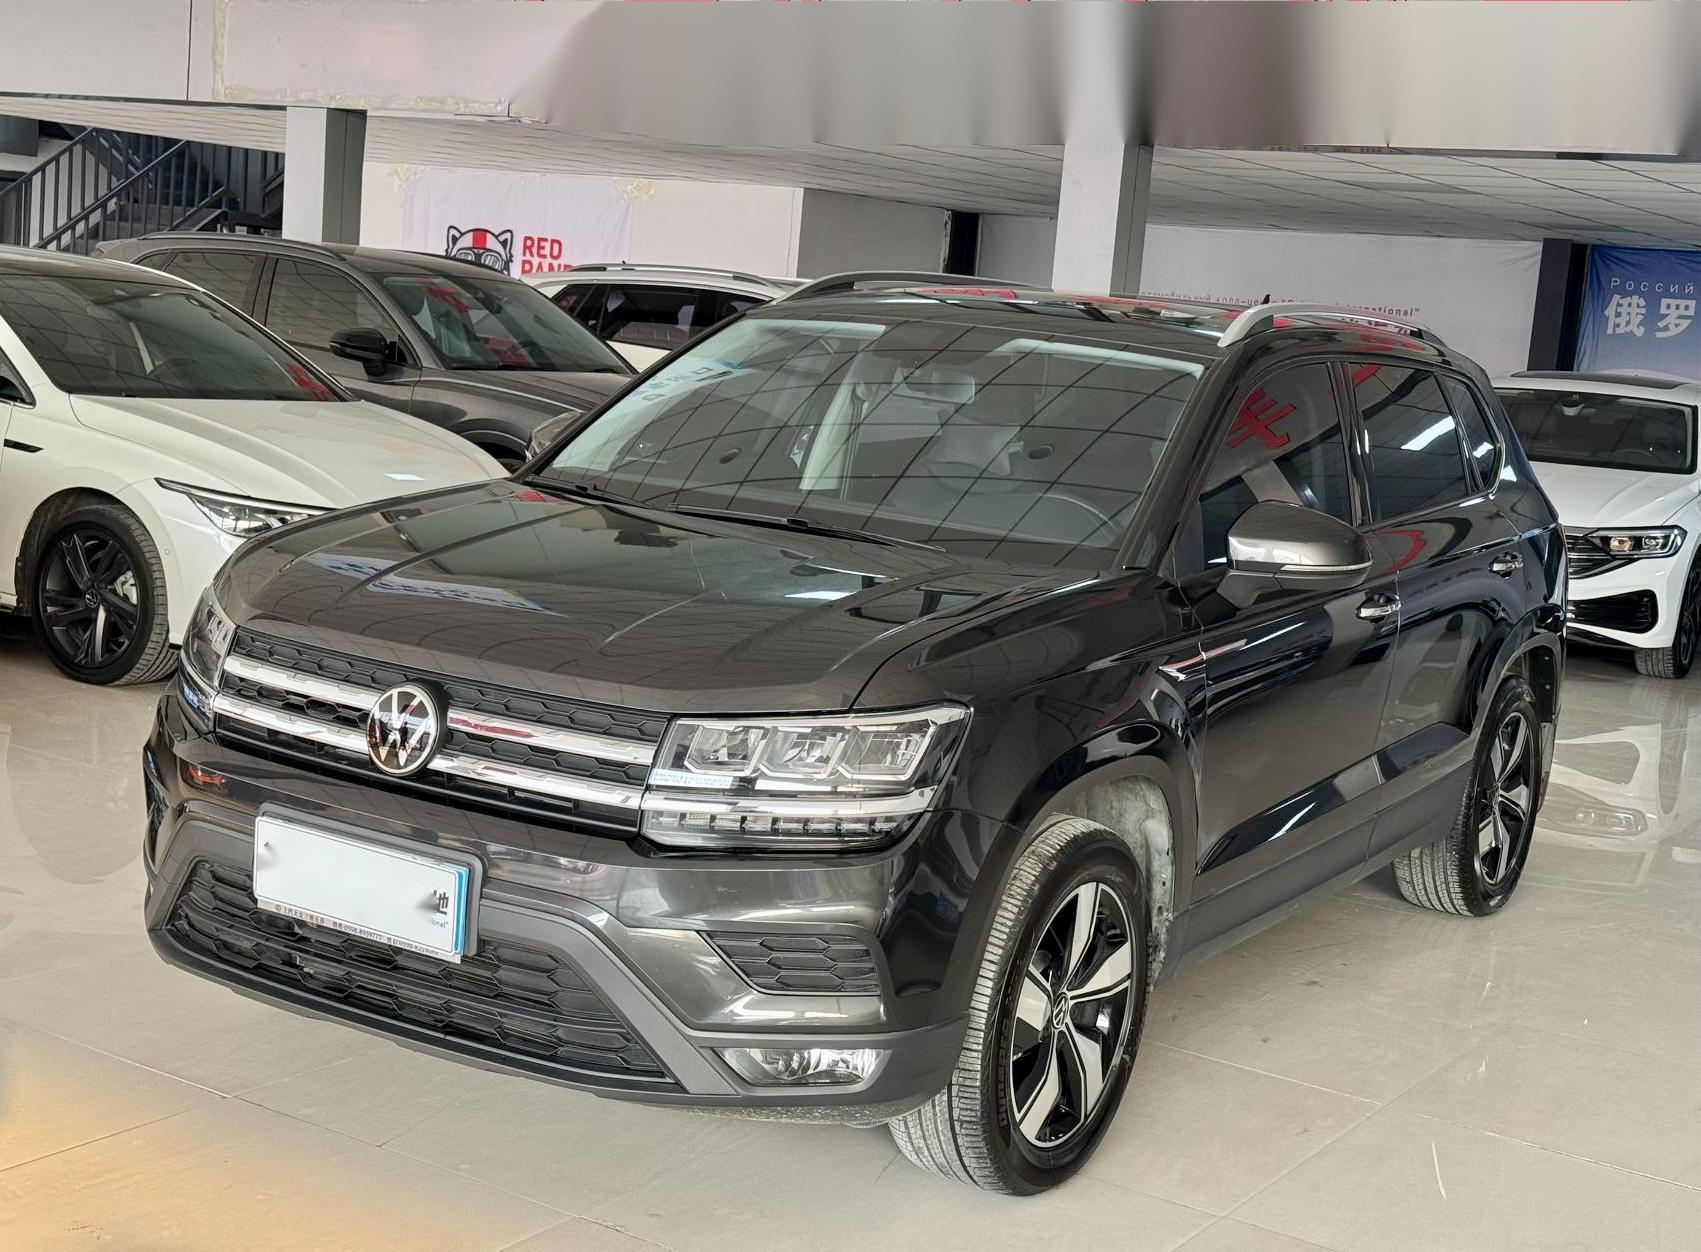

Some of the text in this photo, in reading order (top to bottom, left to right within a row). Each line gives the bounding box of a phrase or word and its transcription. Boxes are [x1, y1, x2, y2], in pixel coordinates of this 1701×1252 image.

[522, 236, 562, 260] RED
[1610, 277, 1694, 294] Россий
[1604, 294, 1696, 338] 俄罗
